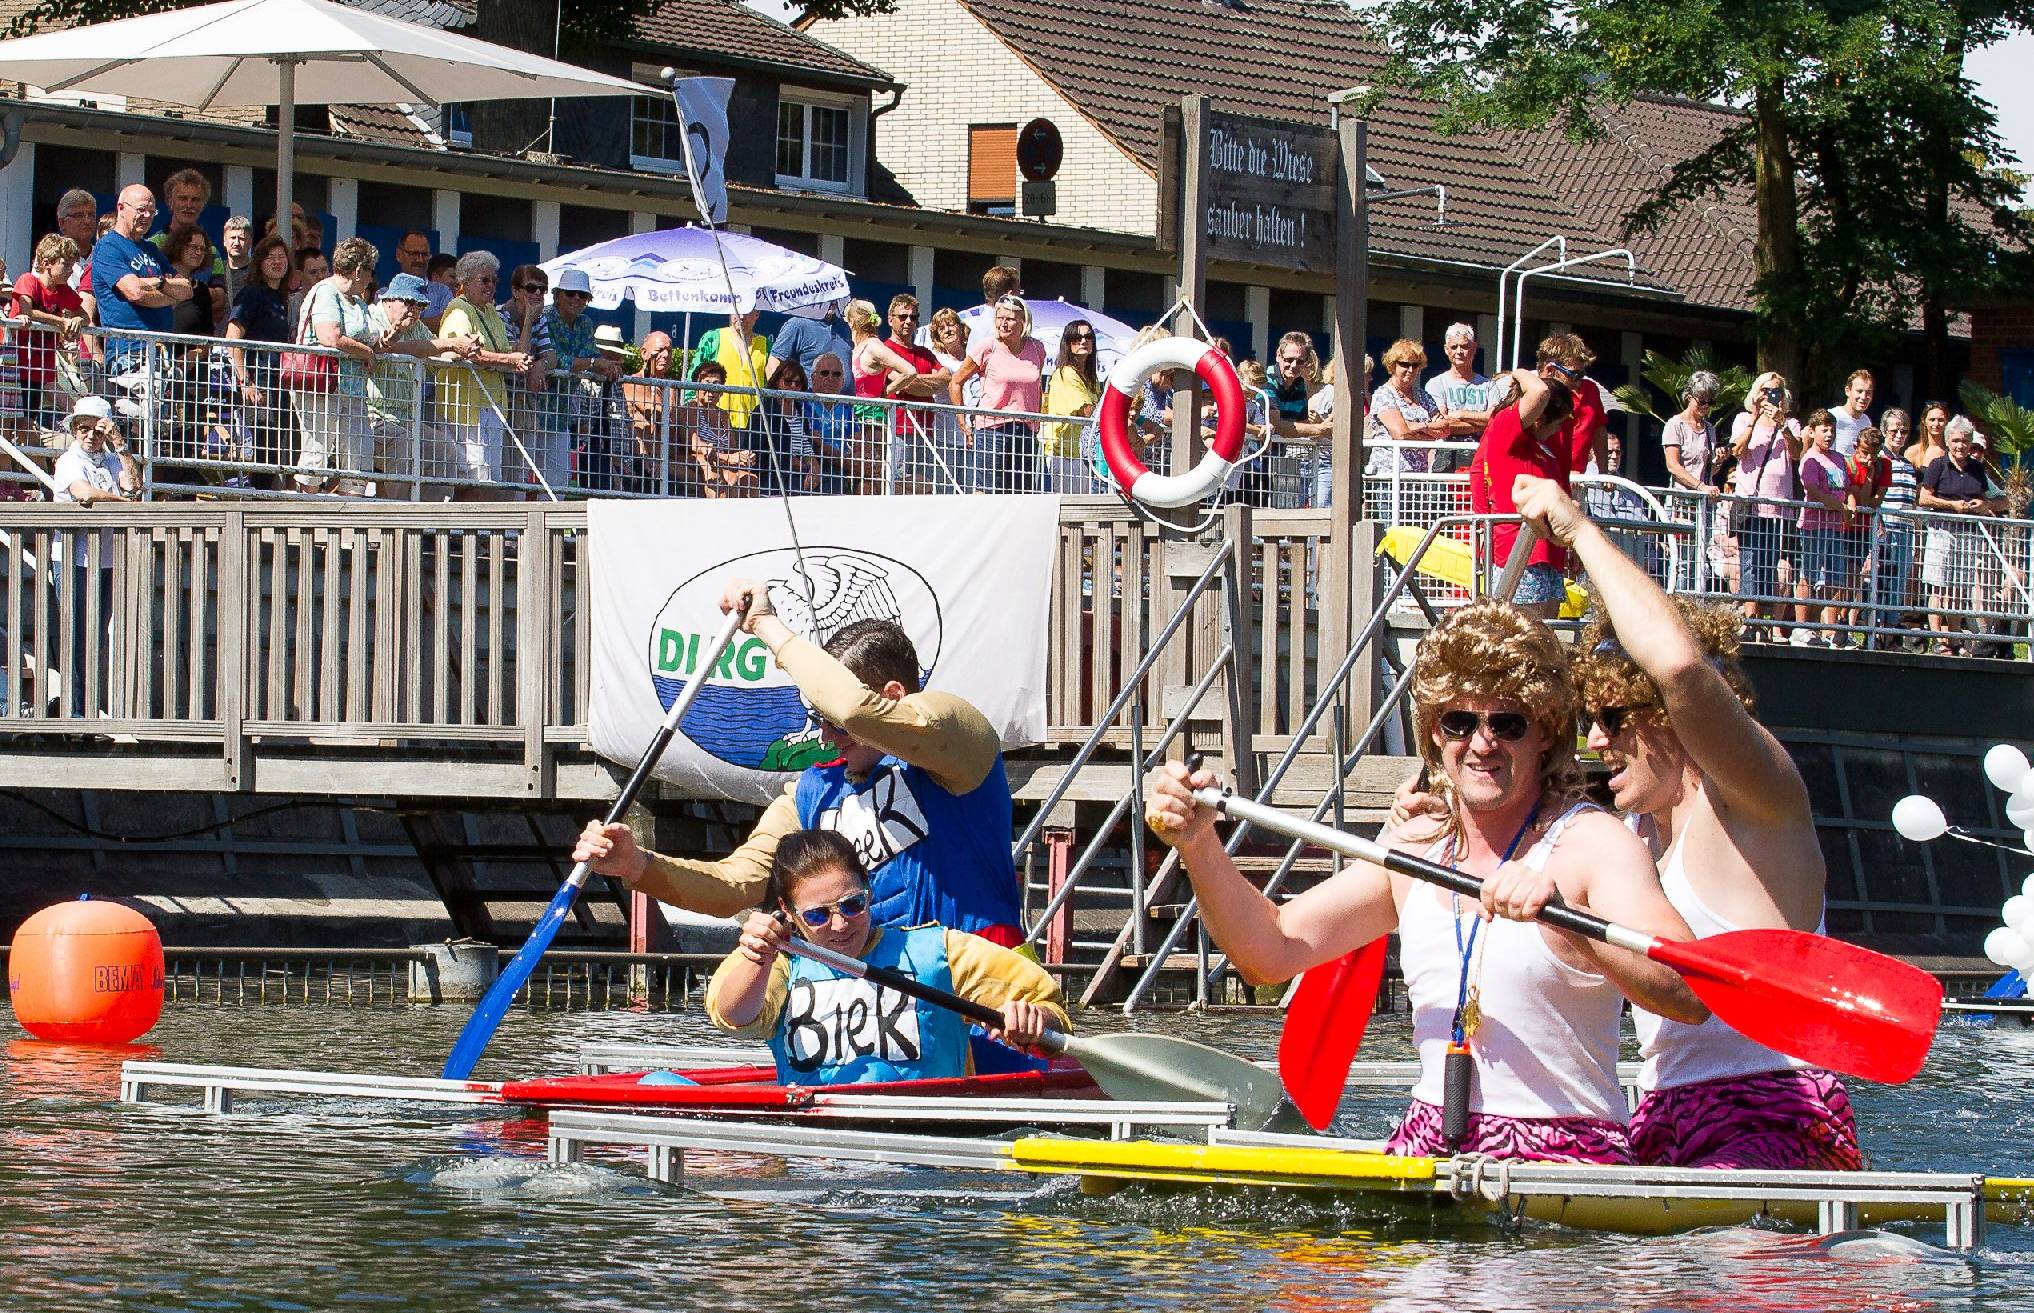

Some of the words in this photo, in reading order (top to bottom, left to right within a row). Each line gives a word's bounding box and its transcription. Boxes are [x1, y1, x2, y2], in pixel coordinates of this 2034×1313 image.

[1209, 128, 1244, 172] Bitte
[1248, 137, 1267, 175] die
[1271, 137, 1313, 183] Wiese
[1207, 200, 1252, 239] sauber
[1256, 203, 1295, 248] halten
[770, 275, 845, 302] Freundeskreis
[1447, 387, 1486, 405] LOST
[95, 964, 143, 992] BEMA
